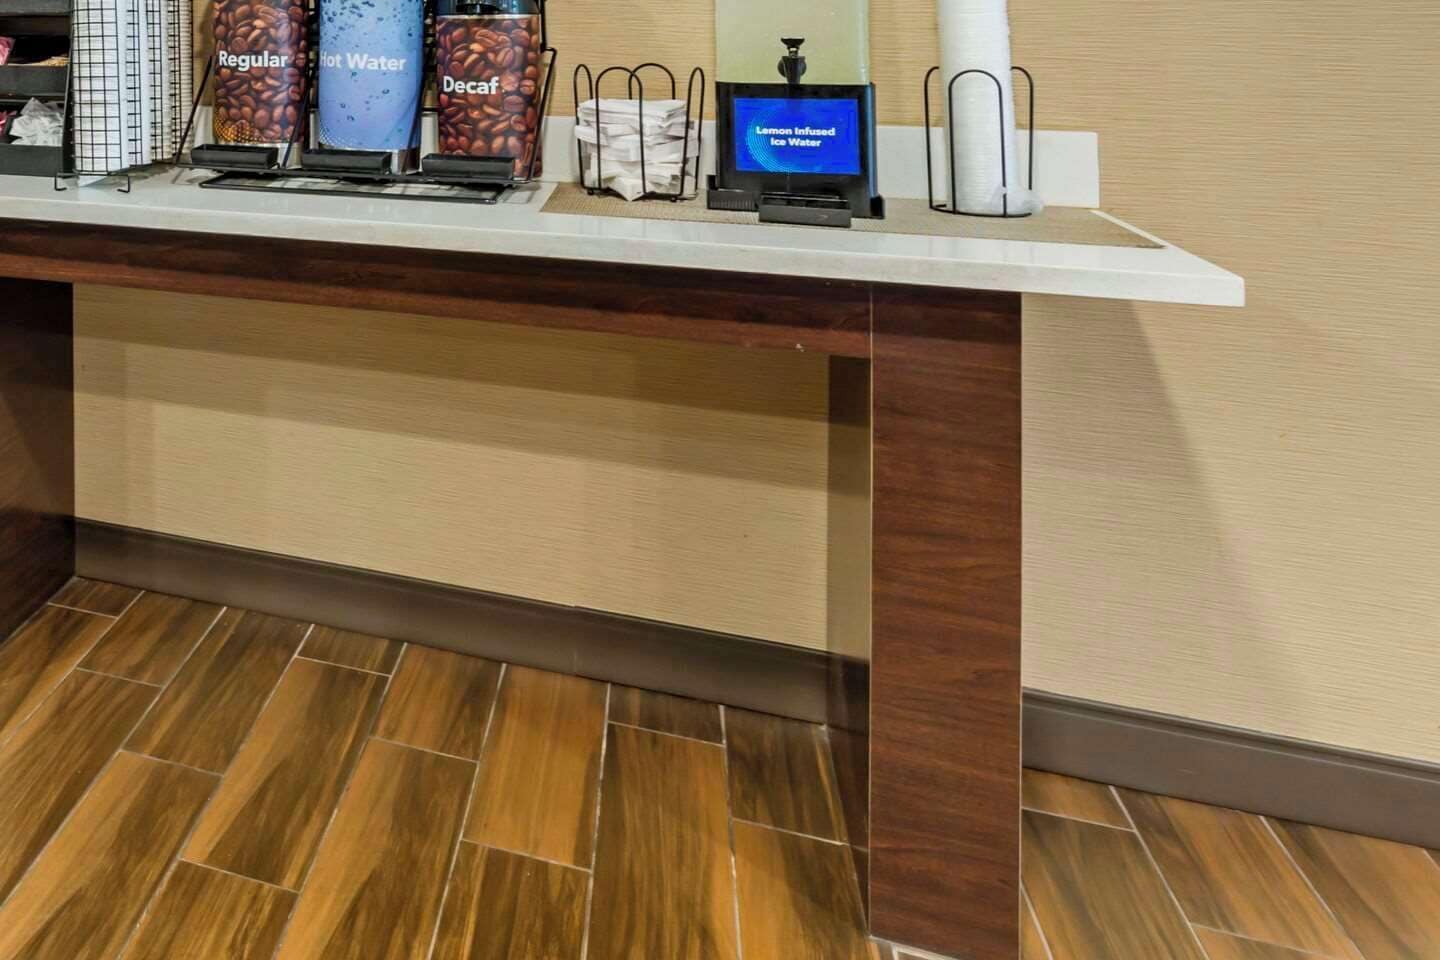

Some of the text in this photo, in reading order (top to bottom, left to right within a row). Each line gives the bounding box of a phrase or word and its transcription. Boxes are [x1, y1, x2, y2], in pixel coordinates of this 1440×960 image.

[219, 50, 288, 72] Regular
[346, 52, 406, 71] Water
[443, 75, 499, 95] Decaf
[755, 126, 836, 136] Lemon Infused
[770, 137, 822, 147] Ice Water
